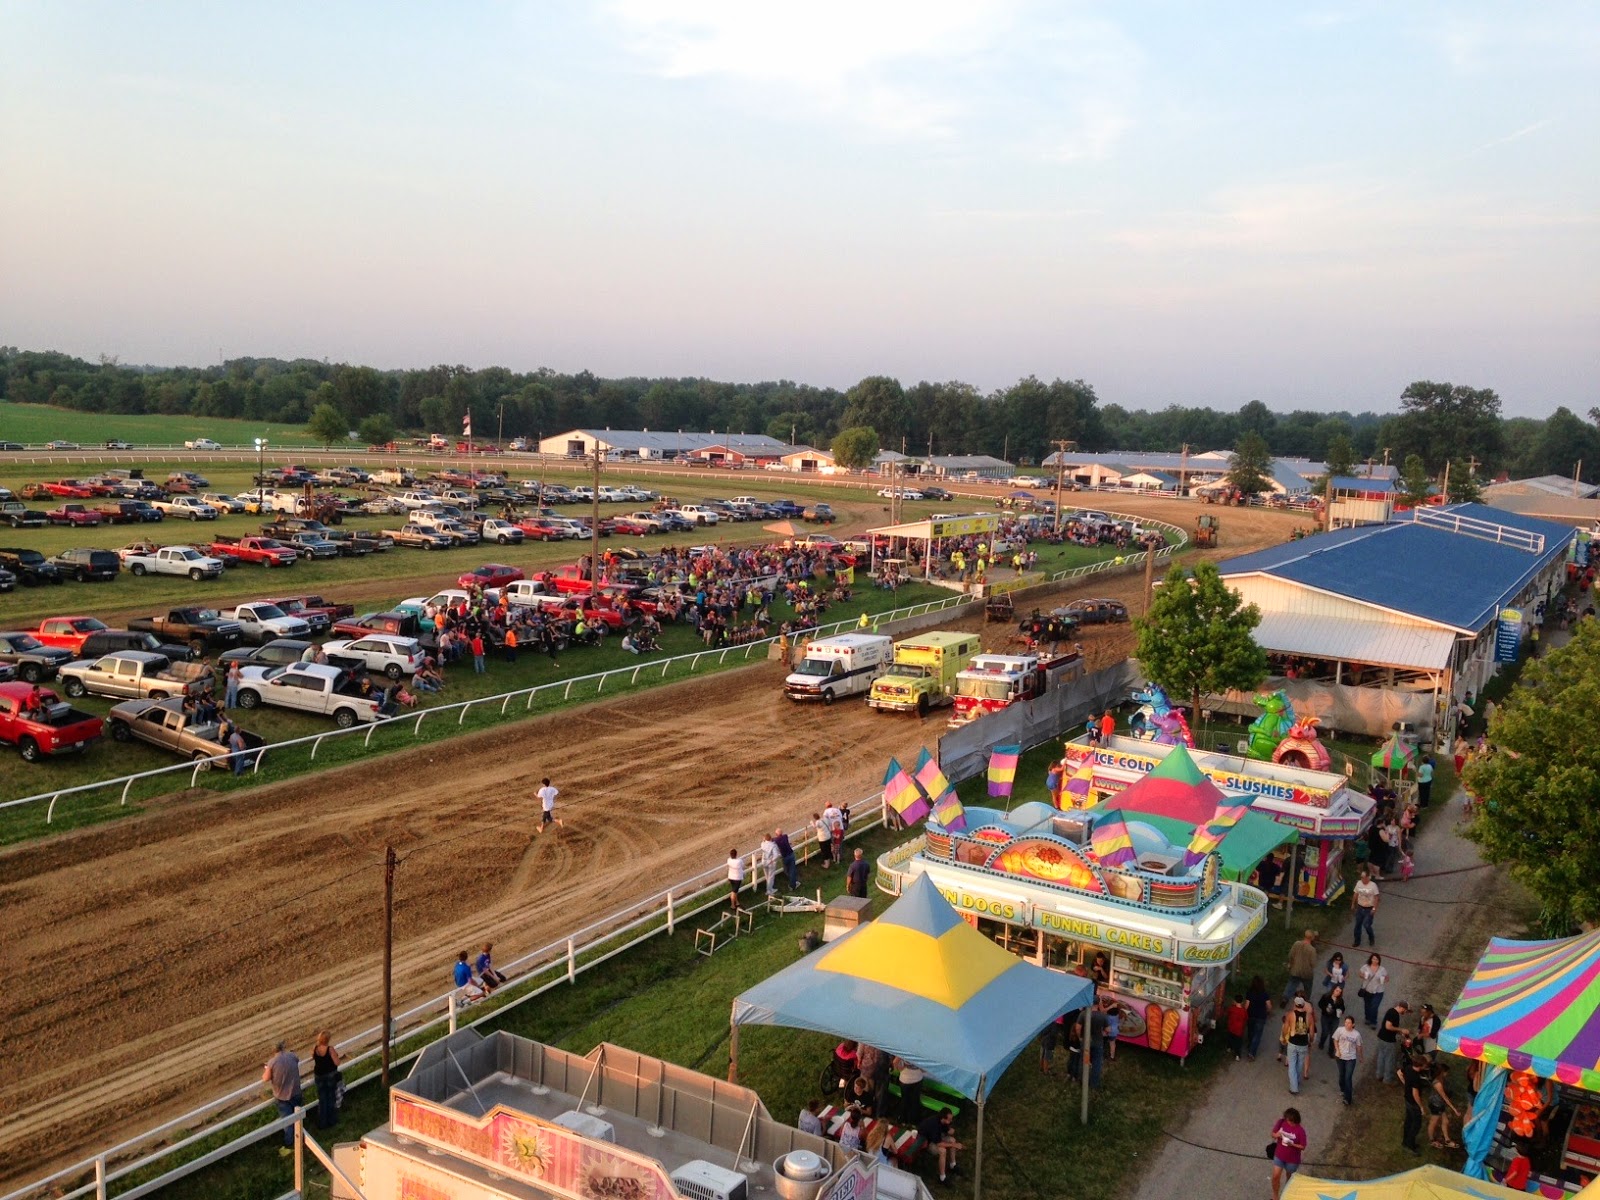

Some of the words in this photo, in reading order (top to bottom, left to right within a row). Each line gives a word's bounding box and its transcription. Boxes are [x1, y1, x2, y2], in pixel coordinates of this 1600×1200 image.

[1095, 752, 1114, 765] ICE
[1119, 757, 1155, 772] COLD
[1226, 777, 1294, 799] SLUSHIES
[962, 894, 1014, 919] DOGS
[1041, 912, 1101, 939] FUNNEL
[1106, 928, 1163, 953] CAKES
